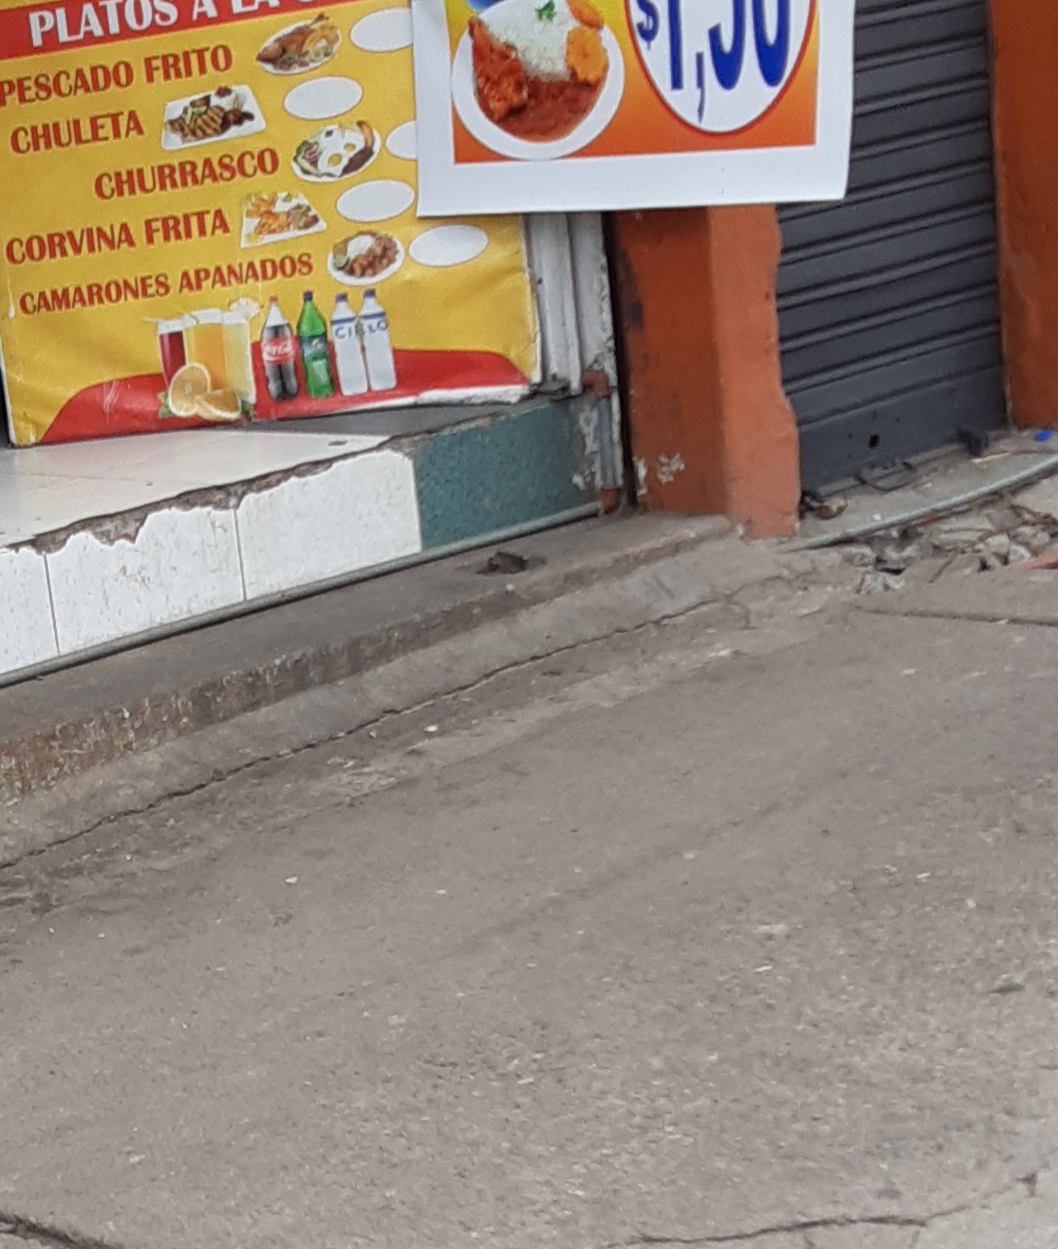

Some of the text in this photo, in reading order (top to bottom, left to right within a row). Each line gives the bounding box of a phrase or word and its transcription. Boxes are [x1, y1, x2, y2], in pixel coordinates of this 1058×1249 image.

[143, 44, 233, 86] FRITO
[9, 110, 145, 155] CHULETA
[93, 148, 281, 201] CHURRASCO
[5, 208, 231, 266] CORVINA FRITA
[19, 252, 314, 317] CAMARONES APANADOS
